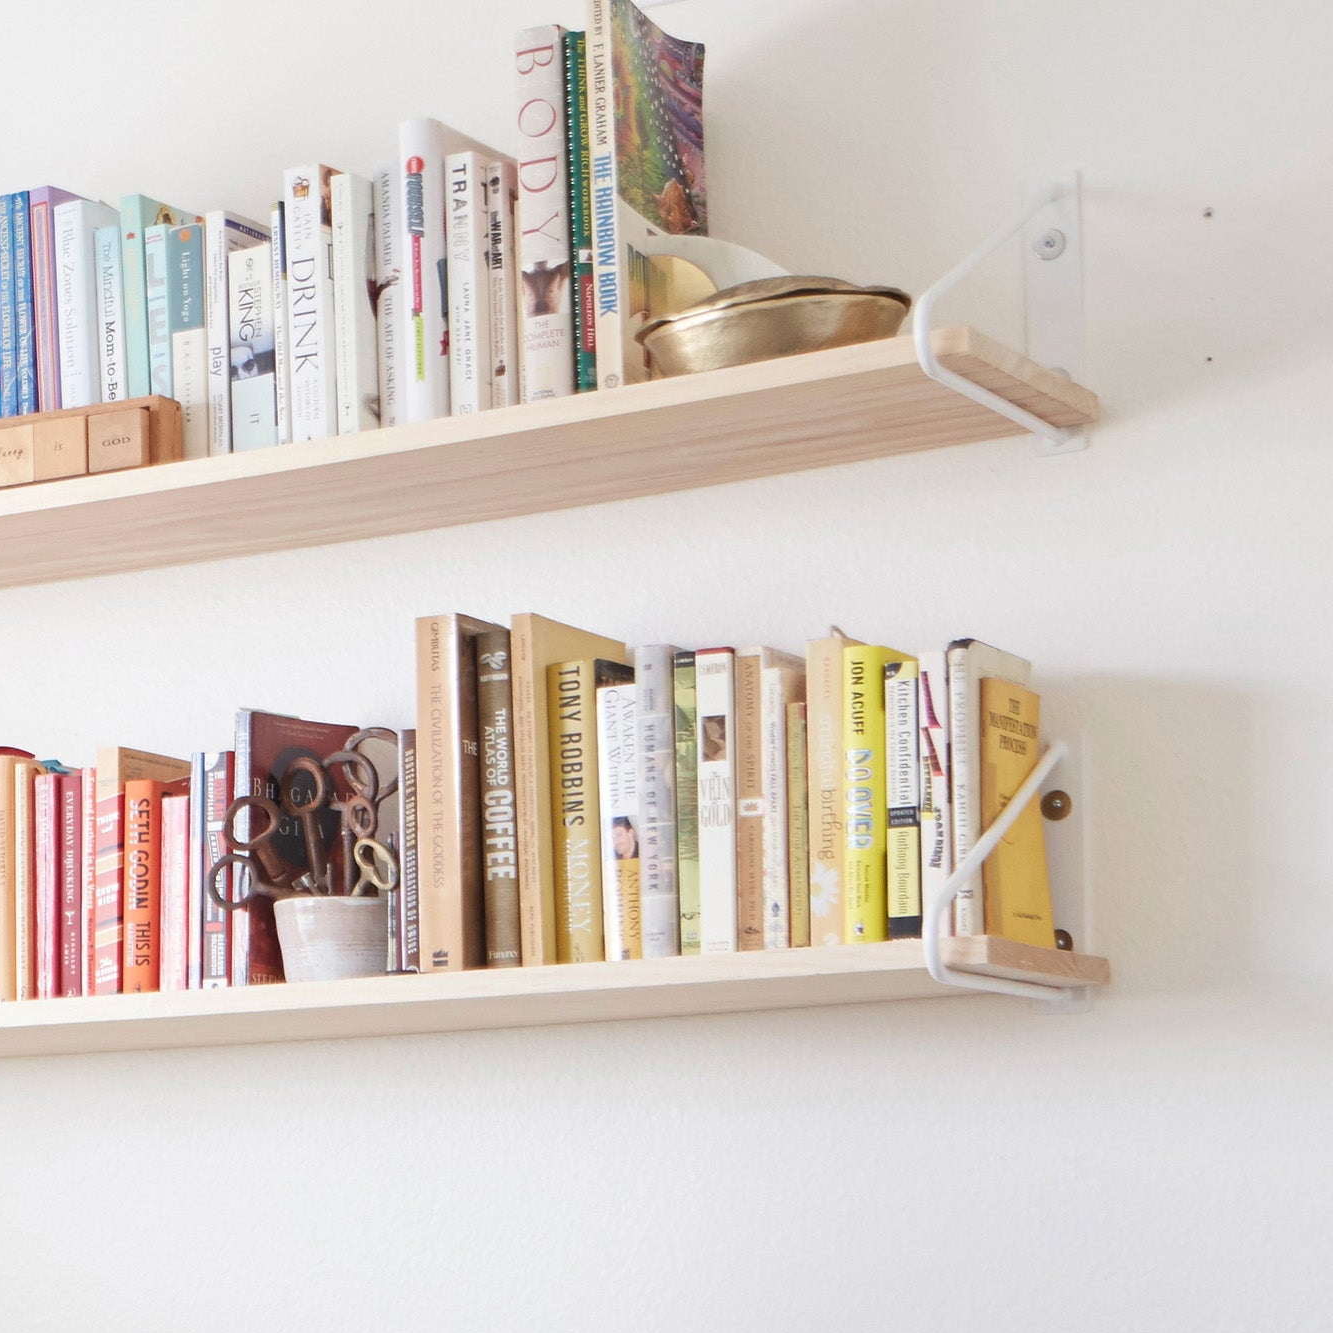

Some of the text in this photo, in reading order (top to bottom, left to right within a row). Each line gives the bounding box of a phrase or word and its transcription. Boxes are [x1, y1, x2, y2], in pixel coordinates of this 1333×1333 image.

[593, 43, 607, 146] F. LANIER GRAHAM
[516, 44, 560, 242] BODY
[293, 206, 302, 251] GATELY
[303, 213, 313, 239] IAIN
[381, 172, 392, 266] AMANDA PALMER
[451, 163, 469, 269] TRANNY
[593, 152, 618, 318] THE RAINBOW BOOK
[61, 228, 79, 368] Blue Zones Solution
[103, 265, 116, 318] Mindful
[181, 251, 193, 322] Light on Yoga
[238, 287, 254, 341] KING
[252, 286, 263, 339] STEPHEN
[291, 257, 319, 374] DRINK
[585, 283, 596, 348] NAPOLEON HILL
[384, 296, 397, 405] THE ART OF ASKING
[526, 340, 560, 351] HUMAN
[534, 320, 550, 329] THE
[105, 321, 118, 401] Mom-to-Be
[209, 346, 225, 376] play
[53, 441, 63, 452] is
[102, 436, 131, 448] GOD
[250, 413, 260, 424] IT
[430, 622, 441, 672] GIMBUTAS
[851, 661, 865, 735] JON ACUFF
[484, 726, 498, 786] ATLAS OF
[495, 708, 509, 785] THE WORLD
[558, 666, 585, 827] TONY ROBBINS
[645, 724, 655, 783] HUMANS
[897, 680, 913, 806] Kitchen Confidential
[998, 734, 1026, 755] PROCESS
[431, 684, 445, 889] THE CIVILIZATION OF THE GODDESS
[623, 768, 637, 800] THE
[645, 792, 656, 807] OF
[700, 778, 731, 800] VEIN
[700, 804, 731, 828] GOLD
[845, 748, 874, 849] DO OVER
[63, 791, 75, 905] EVERYDAY DRINKING
[129, 797, 151, 910] SETH GODIN
[484, 789, 517, 882] COFFEE
[646, 818, 657, 846] NEW
[818, 788, 842, 860] birthing
[571, 837, 591, 933] MONEY
[627, 869, 640, 941] ANTHONY
[648, 856, 659, 891] YORK
[895, 831, 910, 914] Anthony Bourdain
[135, 921, 151, 967] THIS IS
